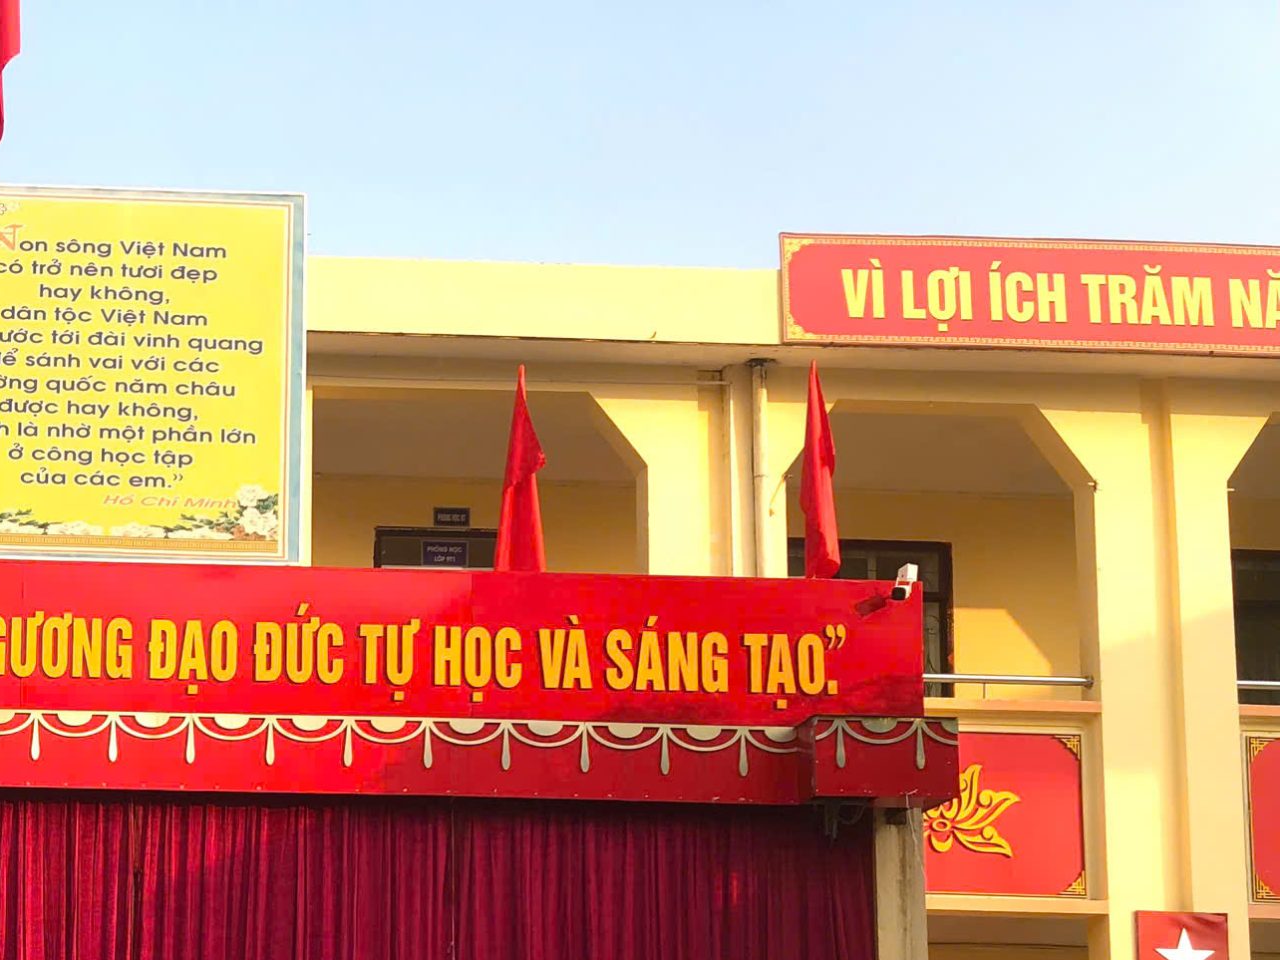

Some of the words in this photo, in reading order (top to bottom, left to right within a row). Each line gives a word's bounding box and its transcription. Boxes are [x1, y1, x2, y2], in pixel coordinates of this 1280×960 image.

[57, 239, 111, 257] sông
[121, 241, 164, 255] Việt
[174, 243, 225, 257] Nam
[32, 260, 61, 275] trở
[71, 263, 112, 276] nên
[122, 264, 161, 278] tươi
[171, 266, 217, 283] đẹp
[40, 284, 81, 301] hay
[91, 286, 169, 305] không,
[842, 258, 885, 318] VÌ
[902, 267, 972, 332] LỢI
[989, 261, 1067, 323] ÍCH
[1081, 265, 1214, 326] TRĂM
[1, 306, 46, 320] dân
[55, 308, 91, 324] tộc
[101, 309, 145, 323] Việt
[154, 311, 206, 325] Nam
[52, 329, 79, 344] tới
[88, 331, 124, 345] đài
[134, 335, 179, 347] vinh
[189, 338, 262, 354] quang
[26, 353, 80, 367] sánh
[90, 356, 122, 368] vai
[132, 356, 164, 370] với
[174, 358, 218, 372] các
[46, 375, 105, 393] quốc
[116, 380, 166, 393] năm
[176, 382, 234, 396] châu
[0, 399, 57, 413] được
[68, 401, 109, 418] hay
[119, 402, 197, 421] không,
[18, 422, 37, 436] là
[48, 424, 90, 438] nhờ
[100, 426, 144, 439] một
[153, 426, 211, 443] phần
[222, 429, 255, 443] lớn
[9, 444, 23, 459] ở
[32, 447, 92, 465] công
[102, 449, 144, 466] học
[155, 451, 192, 467] tập
[21, 468, 65, 484] của
[75, 472, 119, 485] các
[183, 497, 237, 509] Minh
[149, 620, 237, 694] ĐẠO
[254, 604, 343, 683] ĐỨC
[360, 620, 420, 700] TỰ
[435, 626, 521, 701] HỌC
[539, 616, 591, 688] VÀ
[607, 616, 727, 692] SÁNG
[744, 626, 845, 707] TẠO.”
